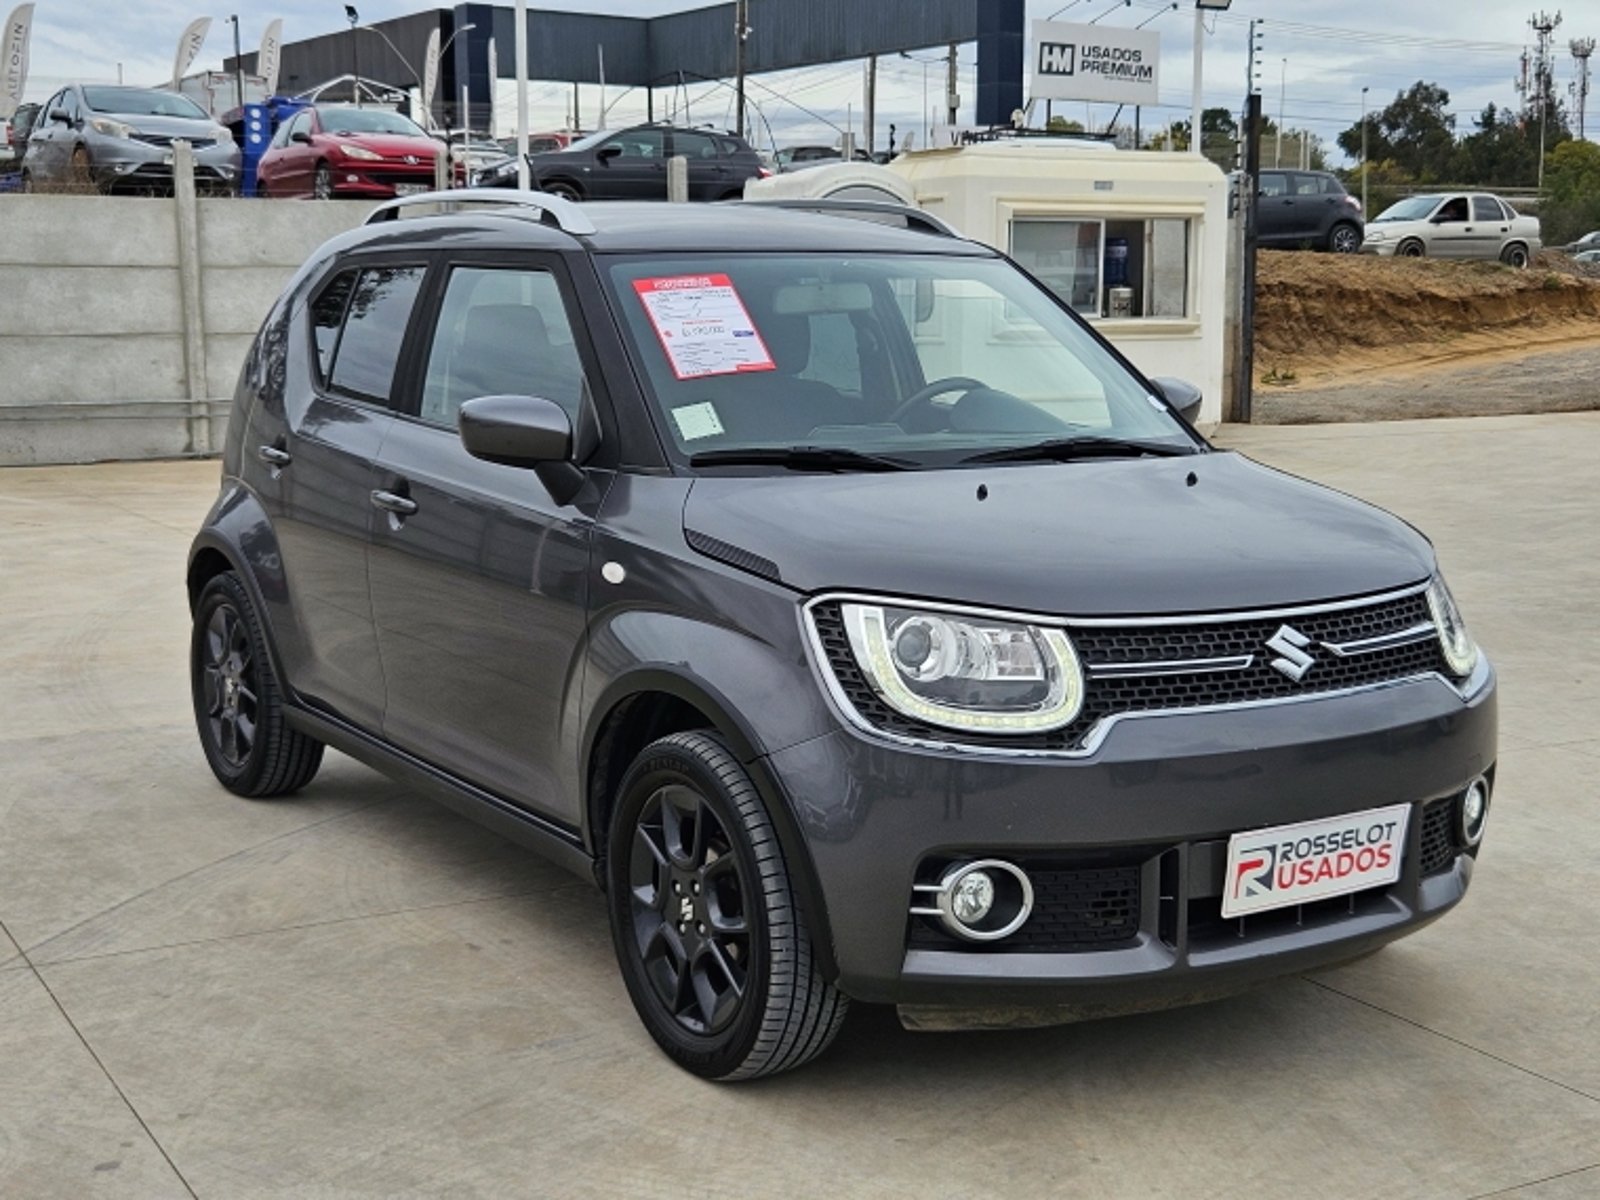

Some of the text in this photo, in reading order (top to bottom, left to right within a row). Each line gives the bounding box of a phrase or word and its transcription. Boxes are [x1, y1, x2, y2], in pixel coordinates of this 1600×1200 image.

[1041, 44, 1073, 73] HM
[1081, 45, 1142, 62] USADOS
[1080, 60, 1153, 79] PREMIUM
[1280, 821, 1397, 864] ROSSELOT
[1277, 843, 1393, 890] USADOS
